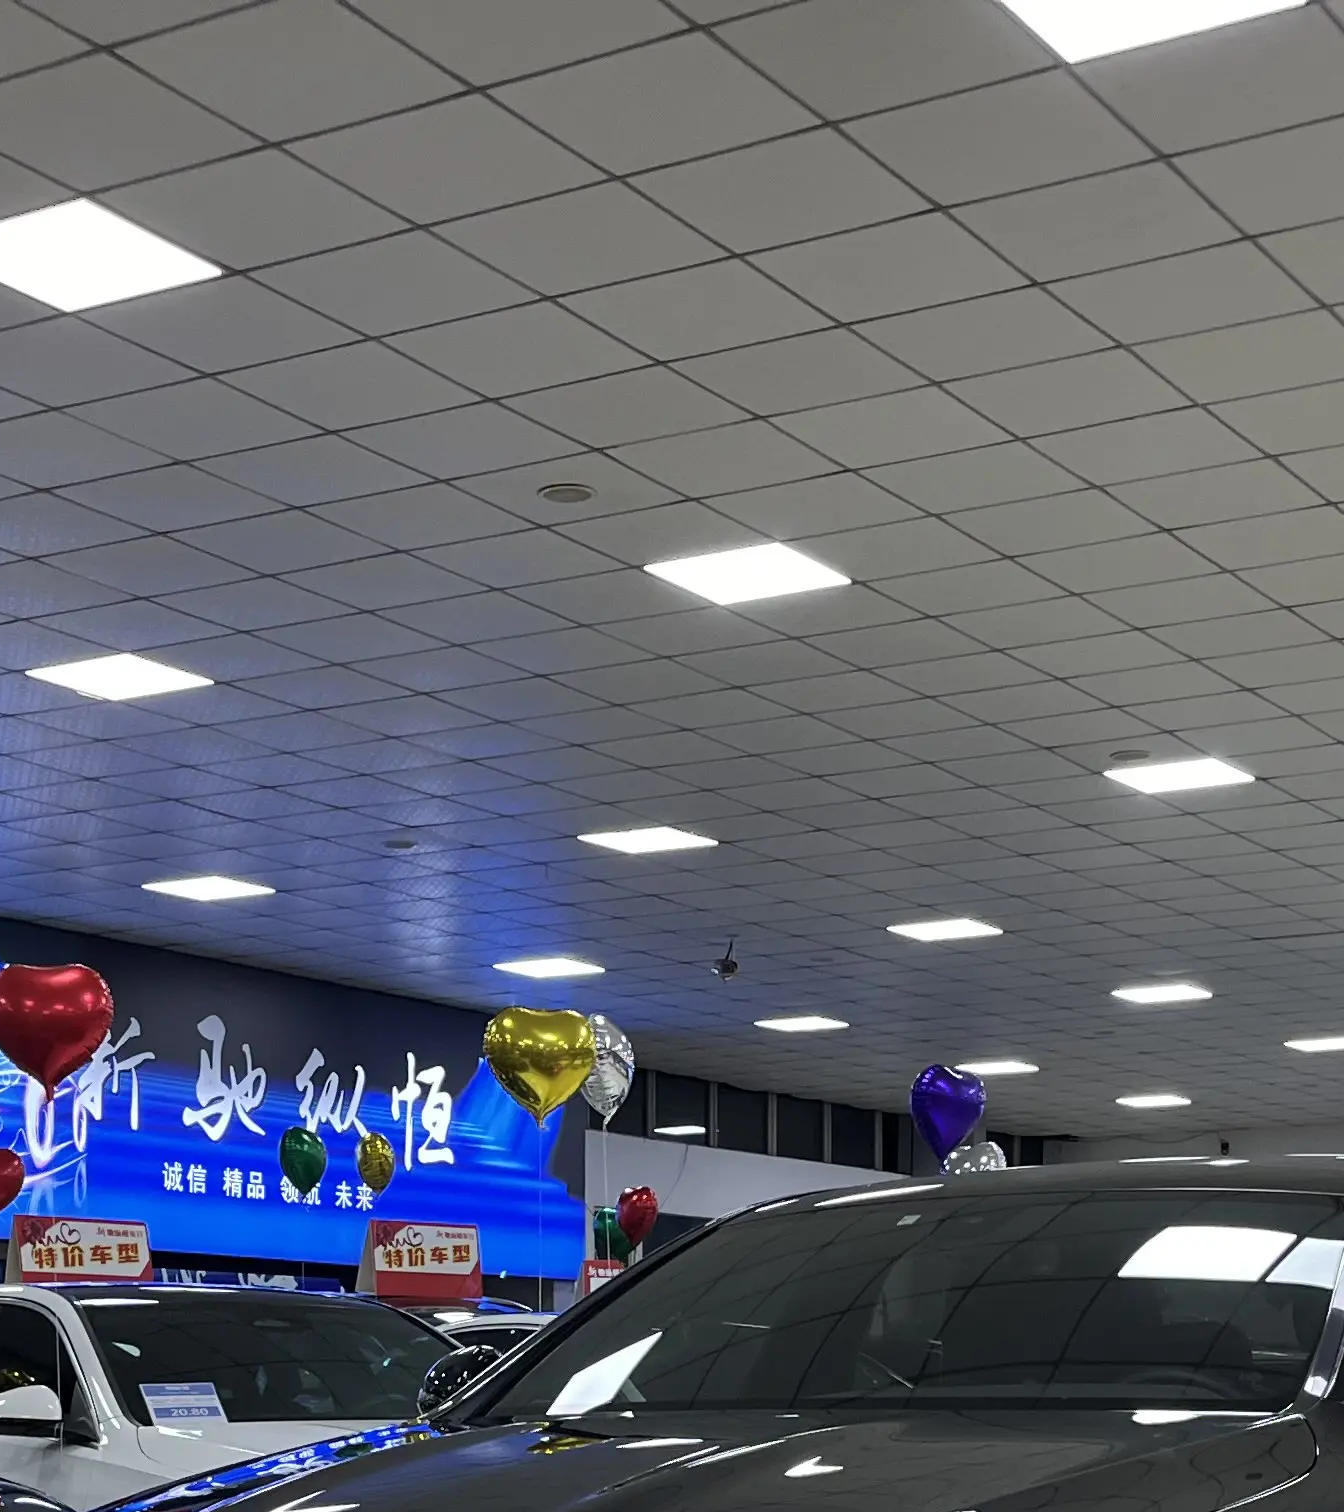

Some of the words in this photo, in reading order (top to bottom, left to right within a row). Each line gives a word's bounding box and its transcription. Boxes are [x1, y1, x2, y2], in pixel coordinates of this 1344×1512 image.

[162, 1162, 207, 1194] 诚信
[223, 1167, 265, 1200] 精品
[335, 1180, 373, 1211] 未来
[33, 1243, 140, 1269] 特价车型
[384, 1245, 471, 1268] 特价车型
